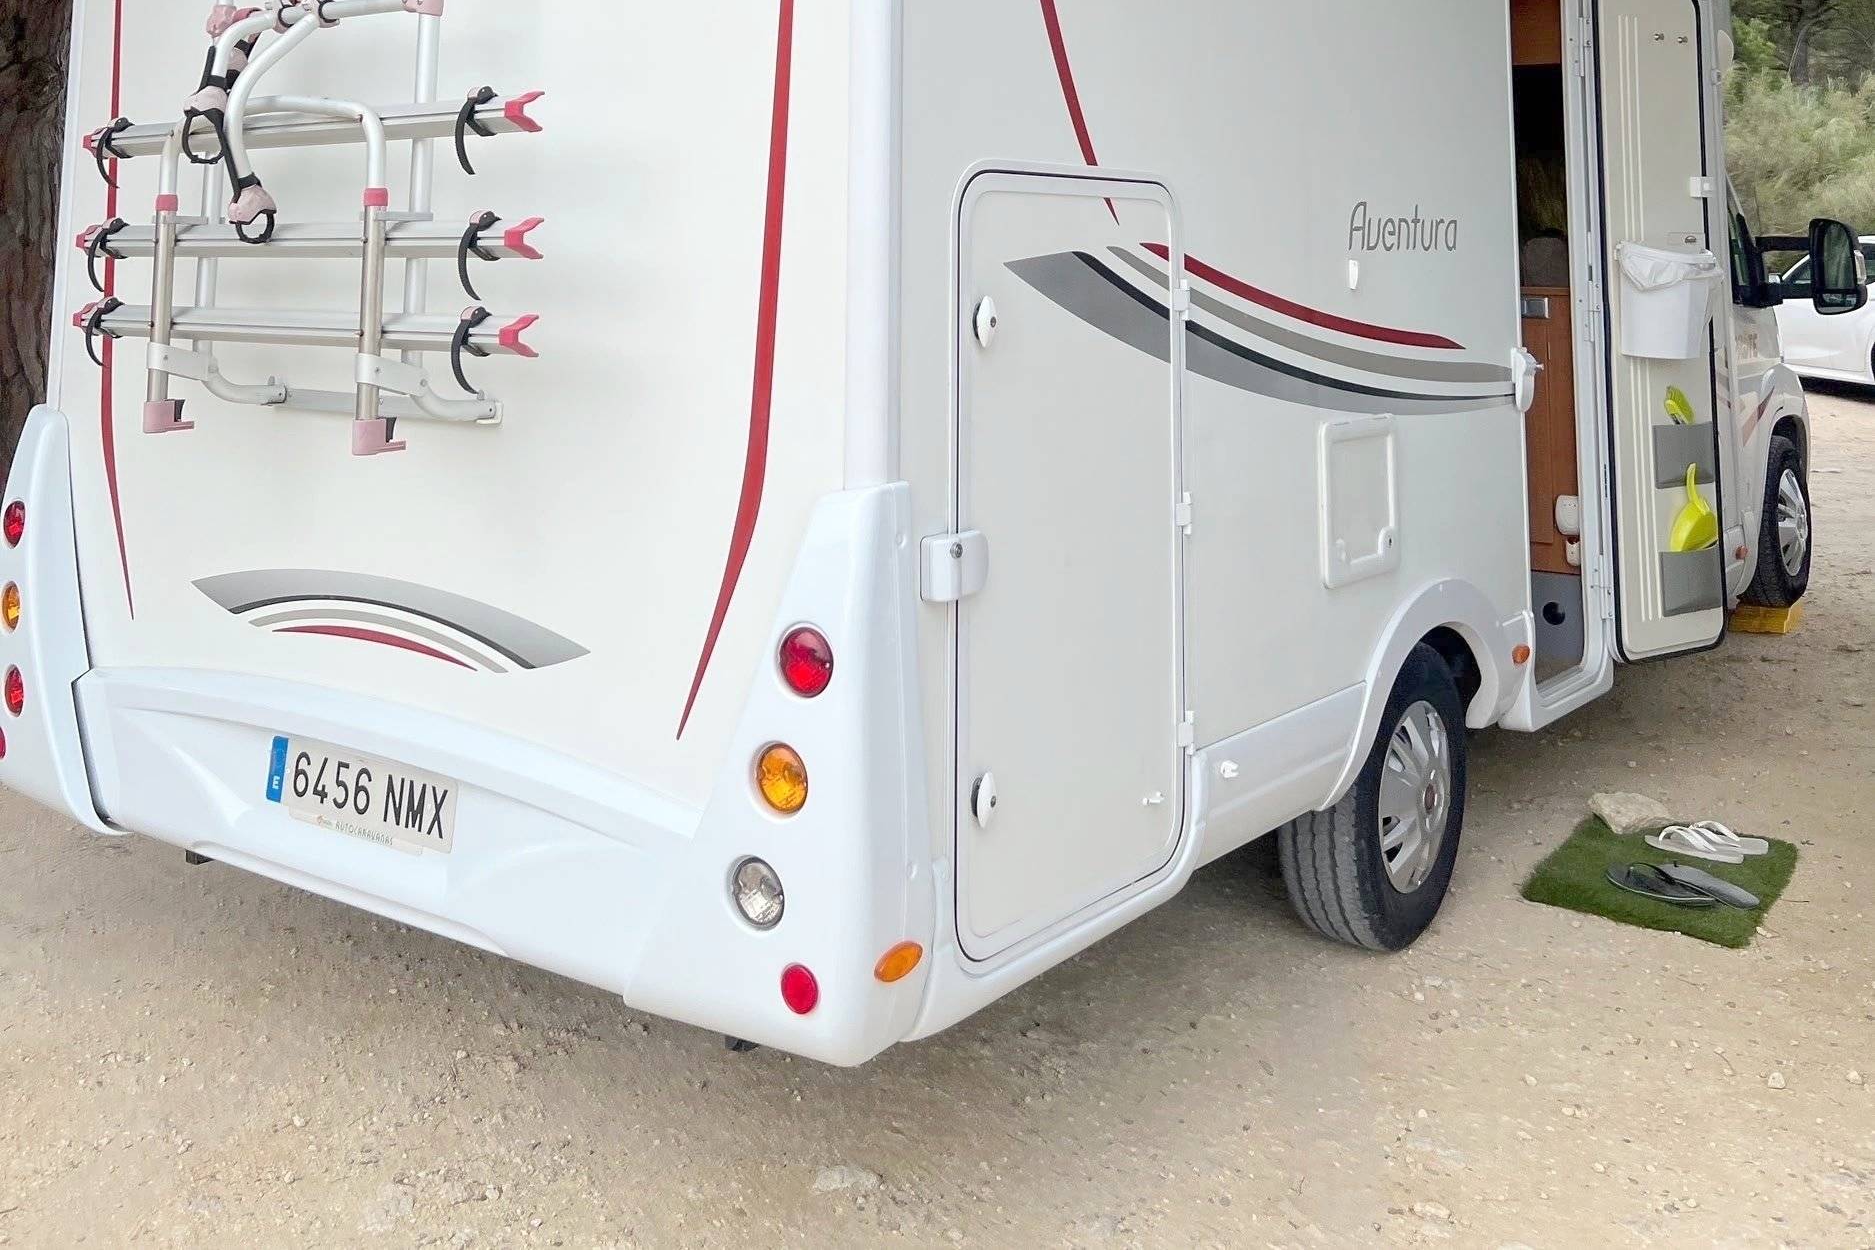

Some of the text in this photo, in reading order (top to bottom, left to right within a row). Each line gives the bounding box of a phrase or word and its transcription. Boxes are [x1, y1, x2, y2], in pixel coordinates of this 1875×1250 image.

[1348, 201, 1458, 252] Aventura
[292, 751, 449, 840] 6456 NMX
